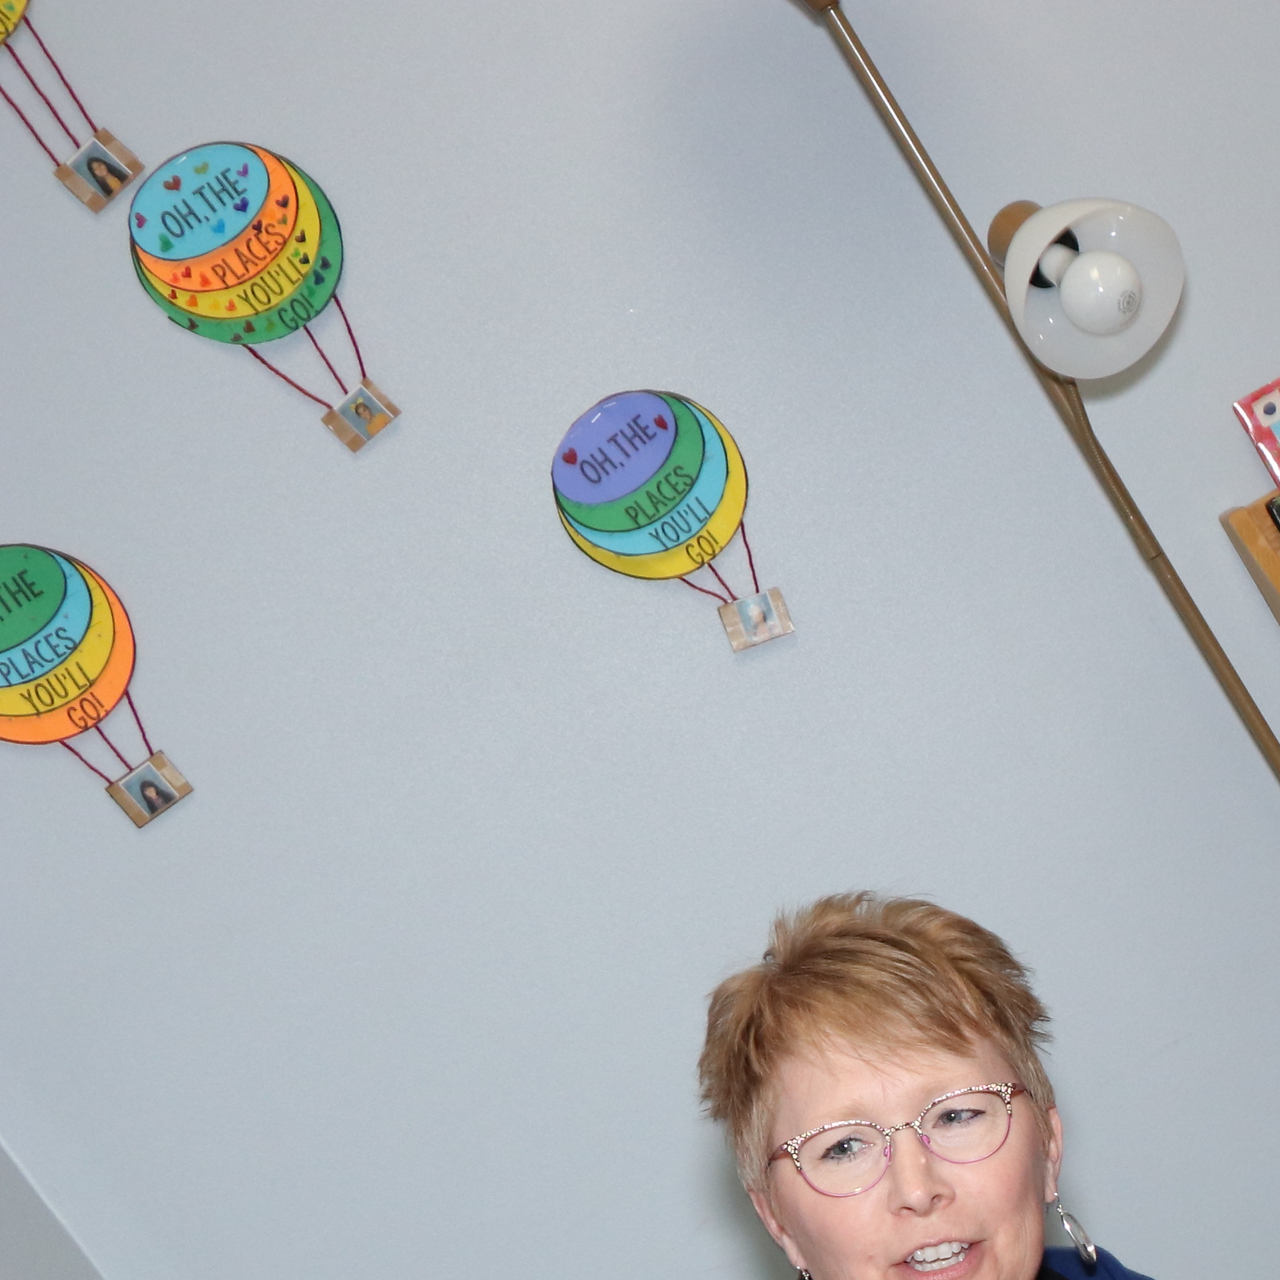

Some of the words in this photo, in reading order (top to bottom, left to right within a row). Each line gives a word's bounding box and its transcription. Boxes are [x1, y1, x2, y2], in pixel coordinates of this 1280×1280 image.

[160, 198, 212, 239] OH,
[192, 167, 248, 213] THE
[211, 222, 288, 288] PLACES
[277, 292, 320, 331] GO!
[579, 447, 625, 485] OH,
[606, 414, 657, 459] THE
[624, 465, 695, 527] PLACES
[685, 529, 724, 567] GO!
[0, 569, 44, 620] HE
[0, 627, 78, 686] PLACES
[19, 661, 96, 715] YOU'LL
[66, 691, 109, 730] GO!
